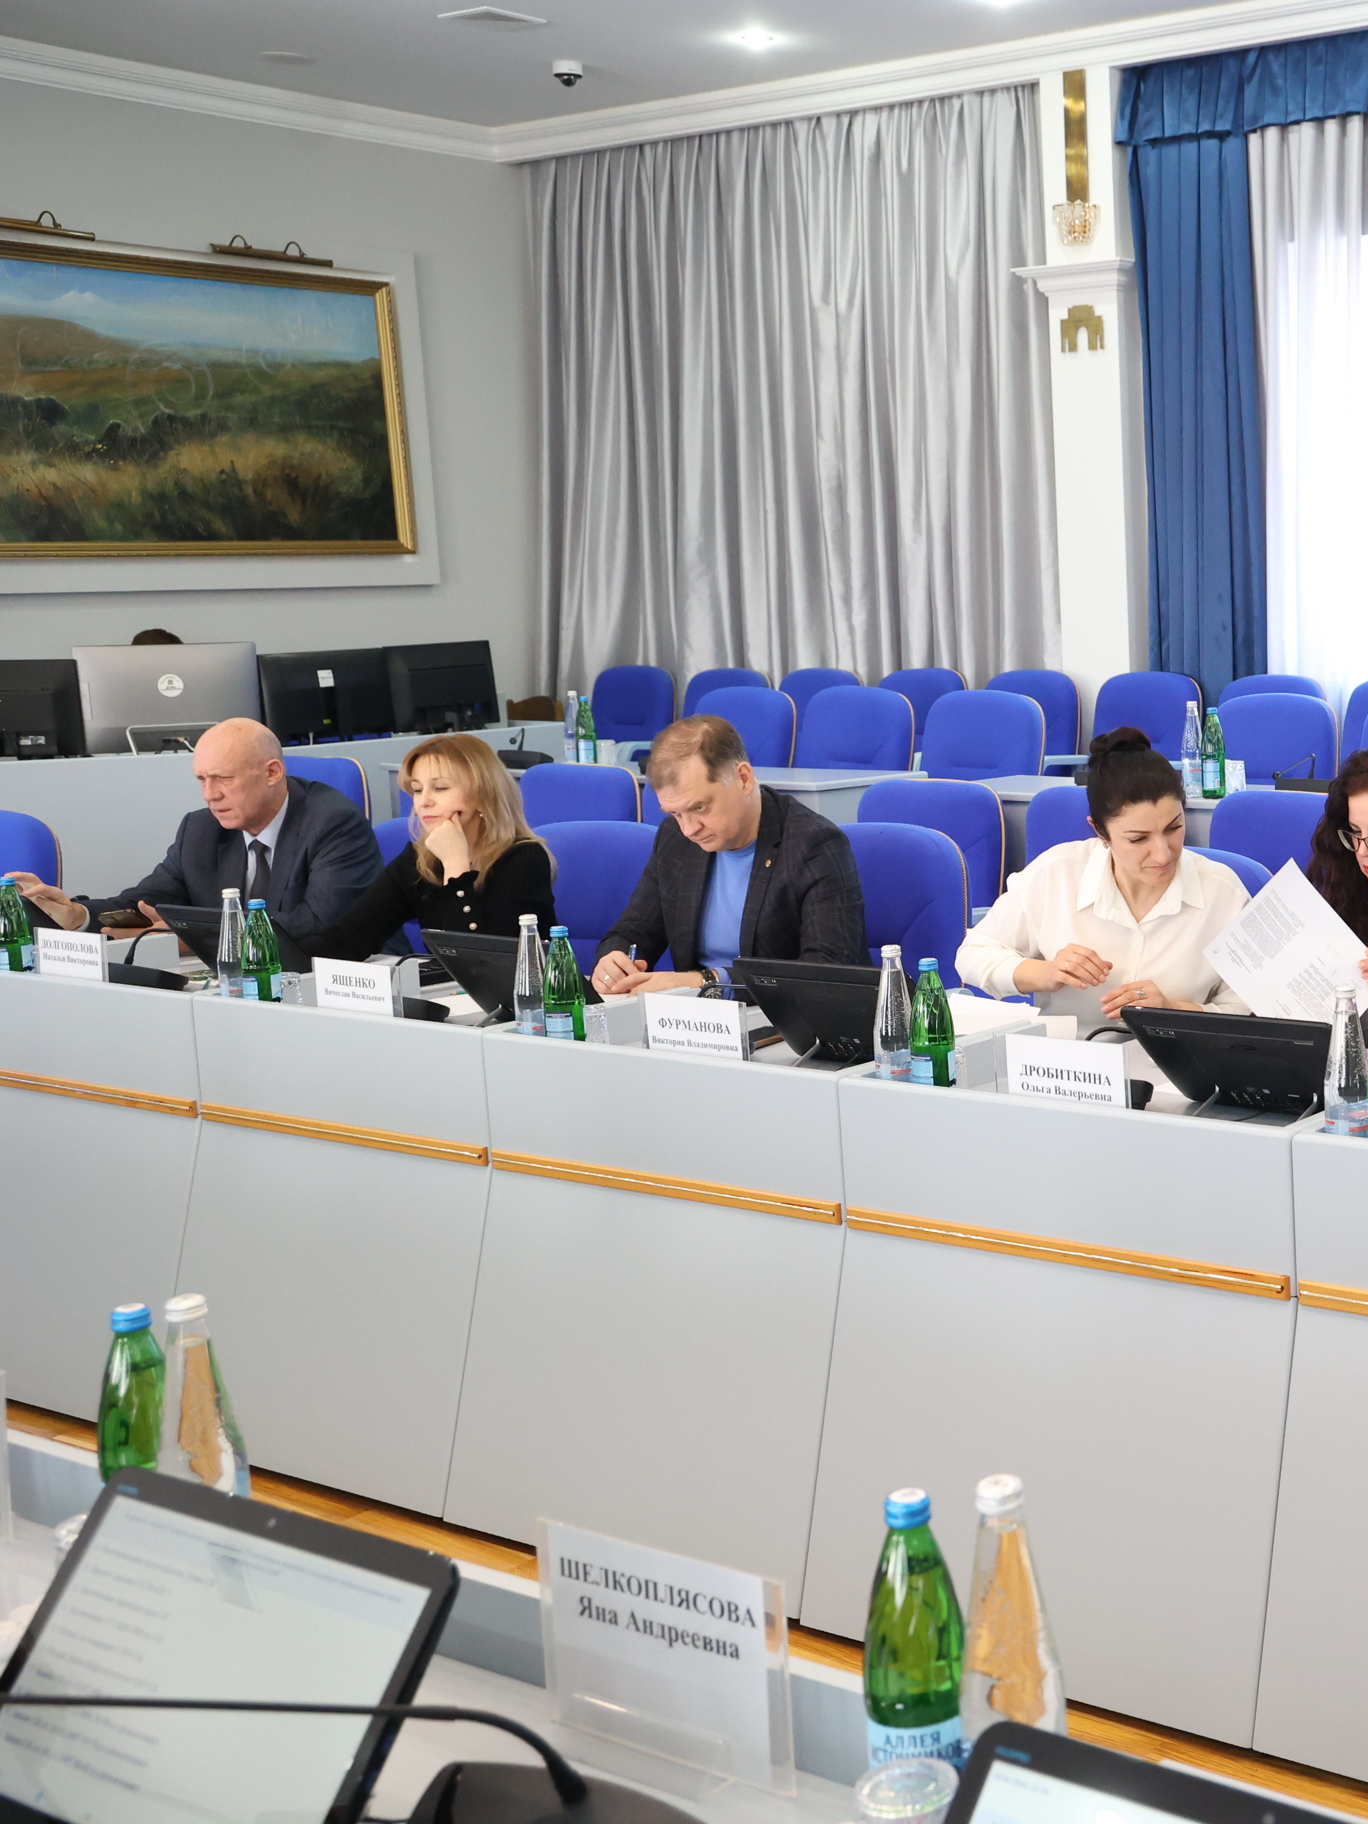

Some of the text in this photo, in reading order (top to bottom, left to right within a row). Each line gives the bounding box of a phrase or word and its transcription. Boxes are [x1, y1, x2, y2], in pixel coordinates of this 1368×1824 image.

[41, 939, 99, 954] ДОЛГОПОЛОВА
[43, 953, 98, 967] Наталья Викторовна
[332, 974, 375, 989] ЯЩЕНКО
[324, 988, 385, 1002] Вячеслав Васильевич
[658, 1018, 731, 1035] ФУРМАНОВА
[652, 1036, 738, 1052] Виктория Владимировна
[1020, 1064, 1112, 1086] ДРОБИТКИНА
[1021, 1082, 1112, 1102] Ольга Валерьевна
[560, 1557, 757, 1628] ШЕЛКОПЛЯСОВА
[579, 1595, 740, 1660] Яна Андреевна
[884, 1731, 941, 1749] АЛЛЕЯ
